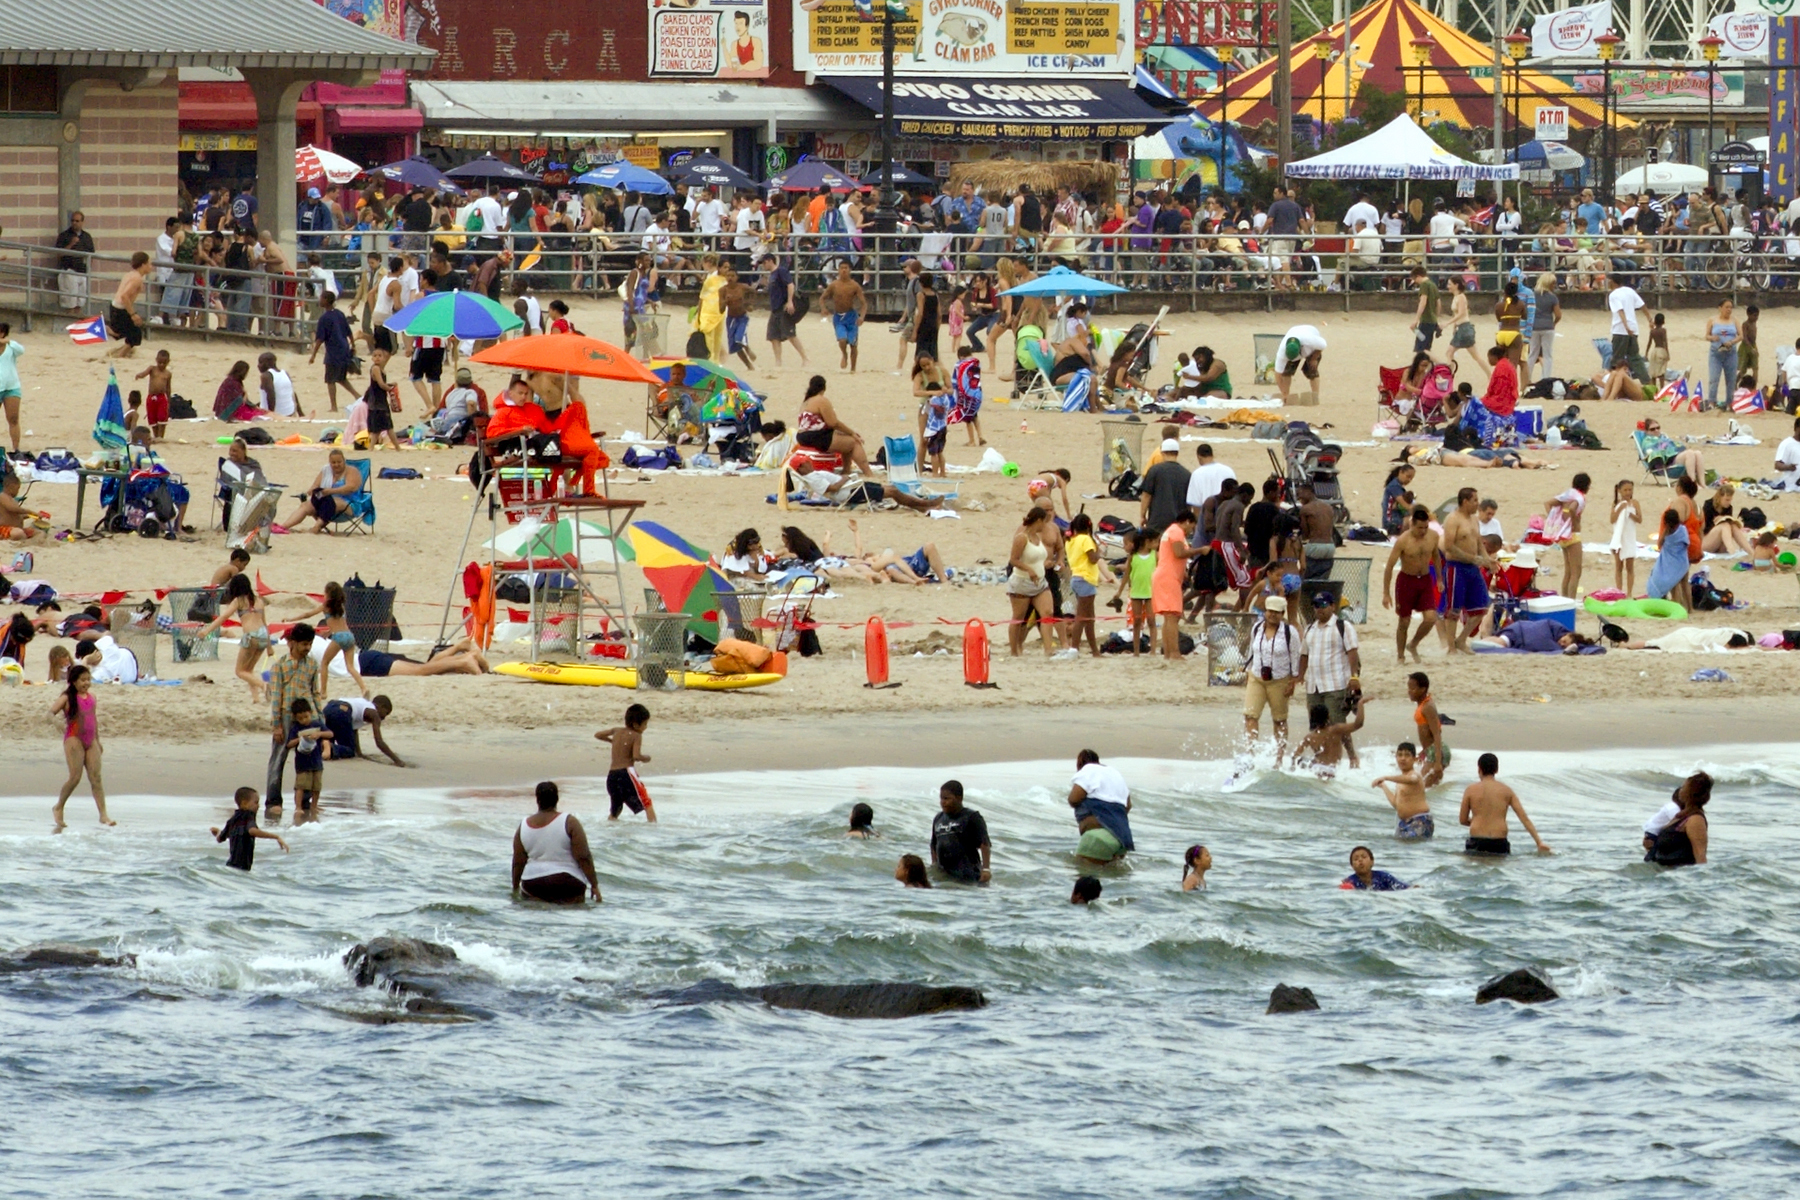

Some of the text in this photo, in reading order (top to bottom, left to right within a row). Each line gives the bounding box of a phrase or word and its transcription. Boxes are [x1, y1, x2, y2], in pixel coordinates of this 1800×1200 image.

[1015, 8, 1059, 16] FRIED CHICKEN
[1065, 8, 1110, 16] PHILLY CHEESE
[663, 15, 714, 25] BAKED CLAMS
[1015, 18, 1059, 26] FRENCH FRIES
[1065, 18, 1104, 26] CORN DOGS
[660, 26, 711, 36] CHICKEN GYRO
[817, 26, 860, 35] FRIED SHRIMP
[1015, 29, 1056, 37] BEEF PATTIES
[1065, 29, 1109, 37] SHISH KABOB
[660, 37, 717, 47] ROASTED CORN
[817, 37, 859, 46] FRIED CLAMS
[1015, 40, 1035, 48] KNISH
[1065, 40, 1090, 48] CANDY
[660, 49, 713, 58] PINA COLADA
[935, 41, 996, 63] CLAM BAR
[844, 54, 856, 65] ON
[859, 54, 877, 65] THE
[1028, 56, 1048, 67] ICE
[660, 60, 713, 70] FUNNEL CAKE
[972, 83, 1103, 102] CORNER
[947, 102, 1090, 118] CLAM BAR
[1539, 109, 1564, 125] ATM
[901, 121, 920, 133] FRIED
[921, 121, 955, 135] CHICKEN
[961, 123, 997, 137] SAUSAGE
[1003, 124, 1030, 137] FRENCH
[1031, 124, 1053, 137] FRIES
[1059, 124, 1075, 137] HOT
[1075, 125, 1090, 138] DOG
[1096, 124, 1117, 137] FRIED
[816, 139, 844, 159] PIZZA
[1718, 154, 1730, 162] West
[1740, 153, 1756, 162] Street
[1333, 164, 1382, 178] ITALIAN
[1453, 164, 1493, 180] ITALIAN
[991, 212, 1002, 223] 10
